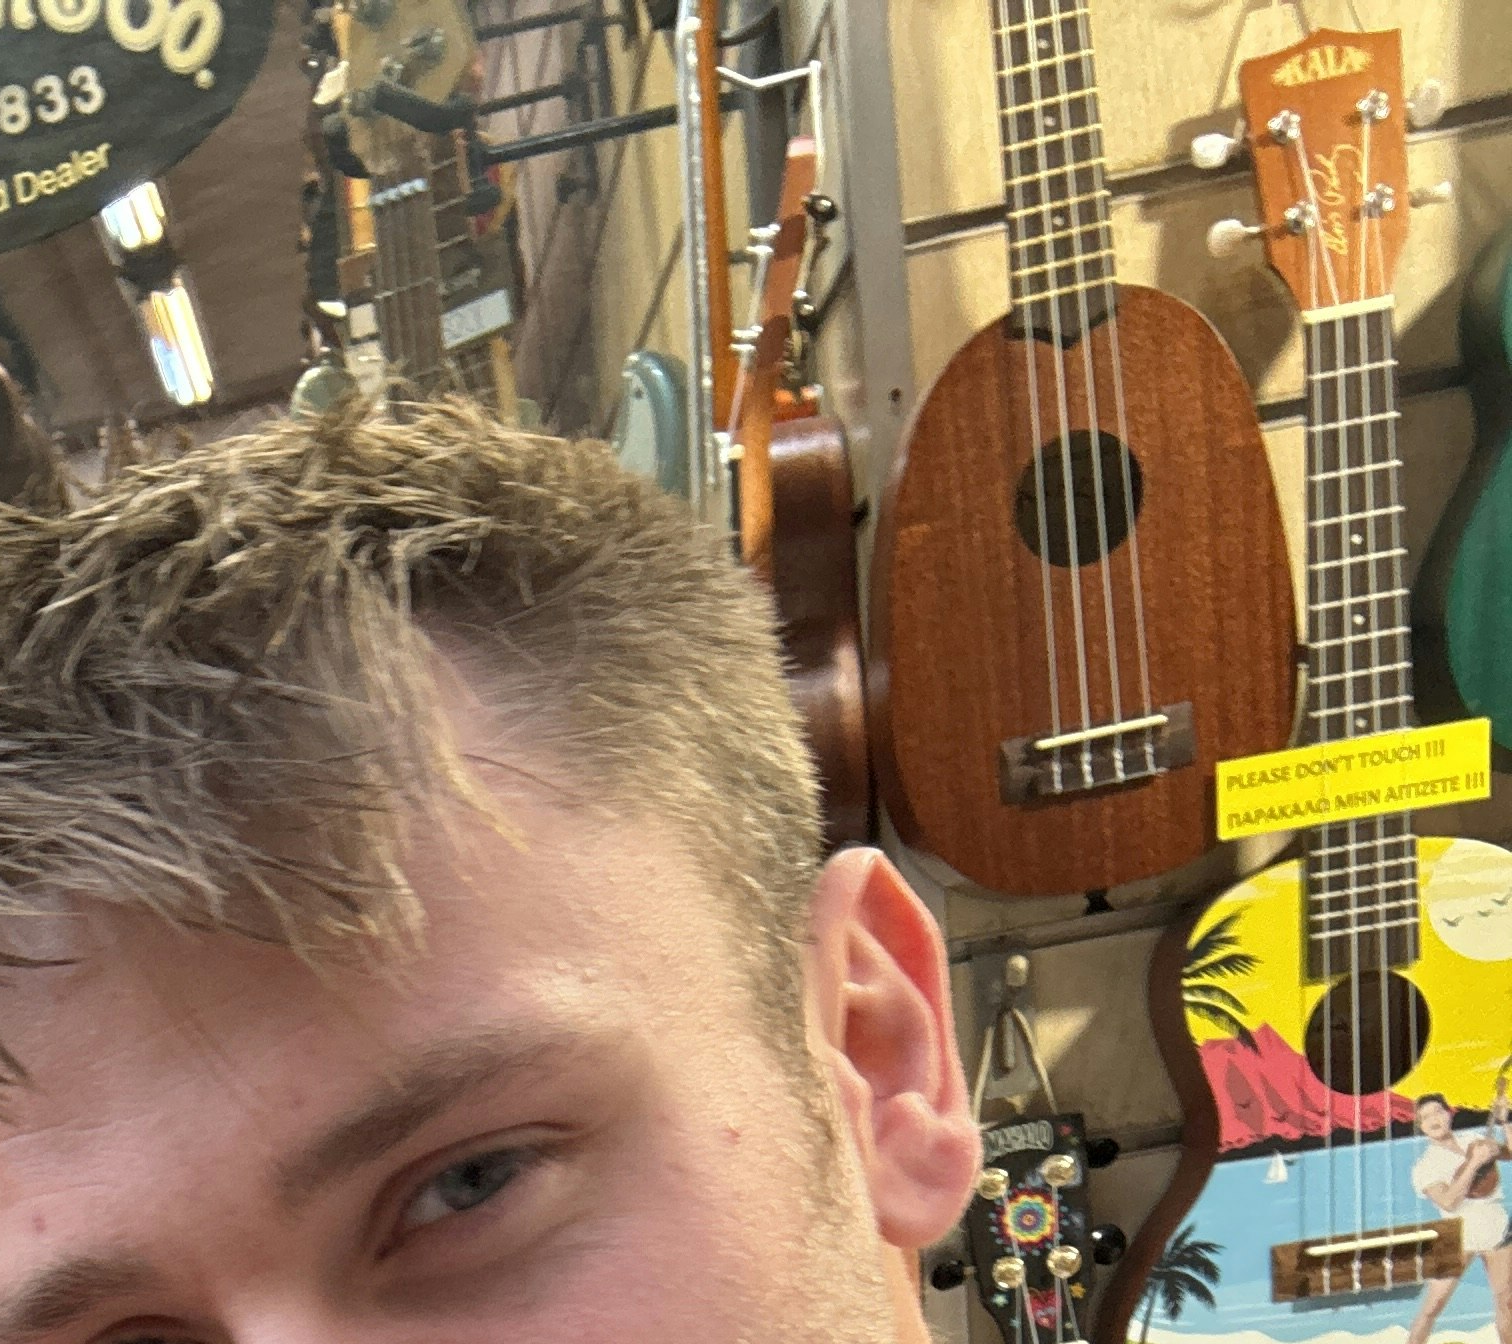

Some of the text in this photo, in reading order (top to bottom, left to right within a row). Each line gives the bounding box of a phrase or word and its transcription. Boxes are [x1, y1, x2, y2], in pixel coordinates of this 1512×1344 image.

[12, 142, 112, 204] Dealer
[1226, 765, 1291, 792] PLEASE
[1294, 754, 1355, 780] DON'T
[1357, 744, 1421, 769] TOUCH
